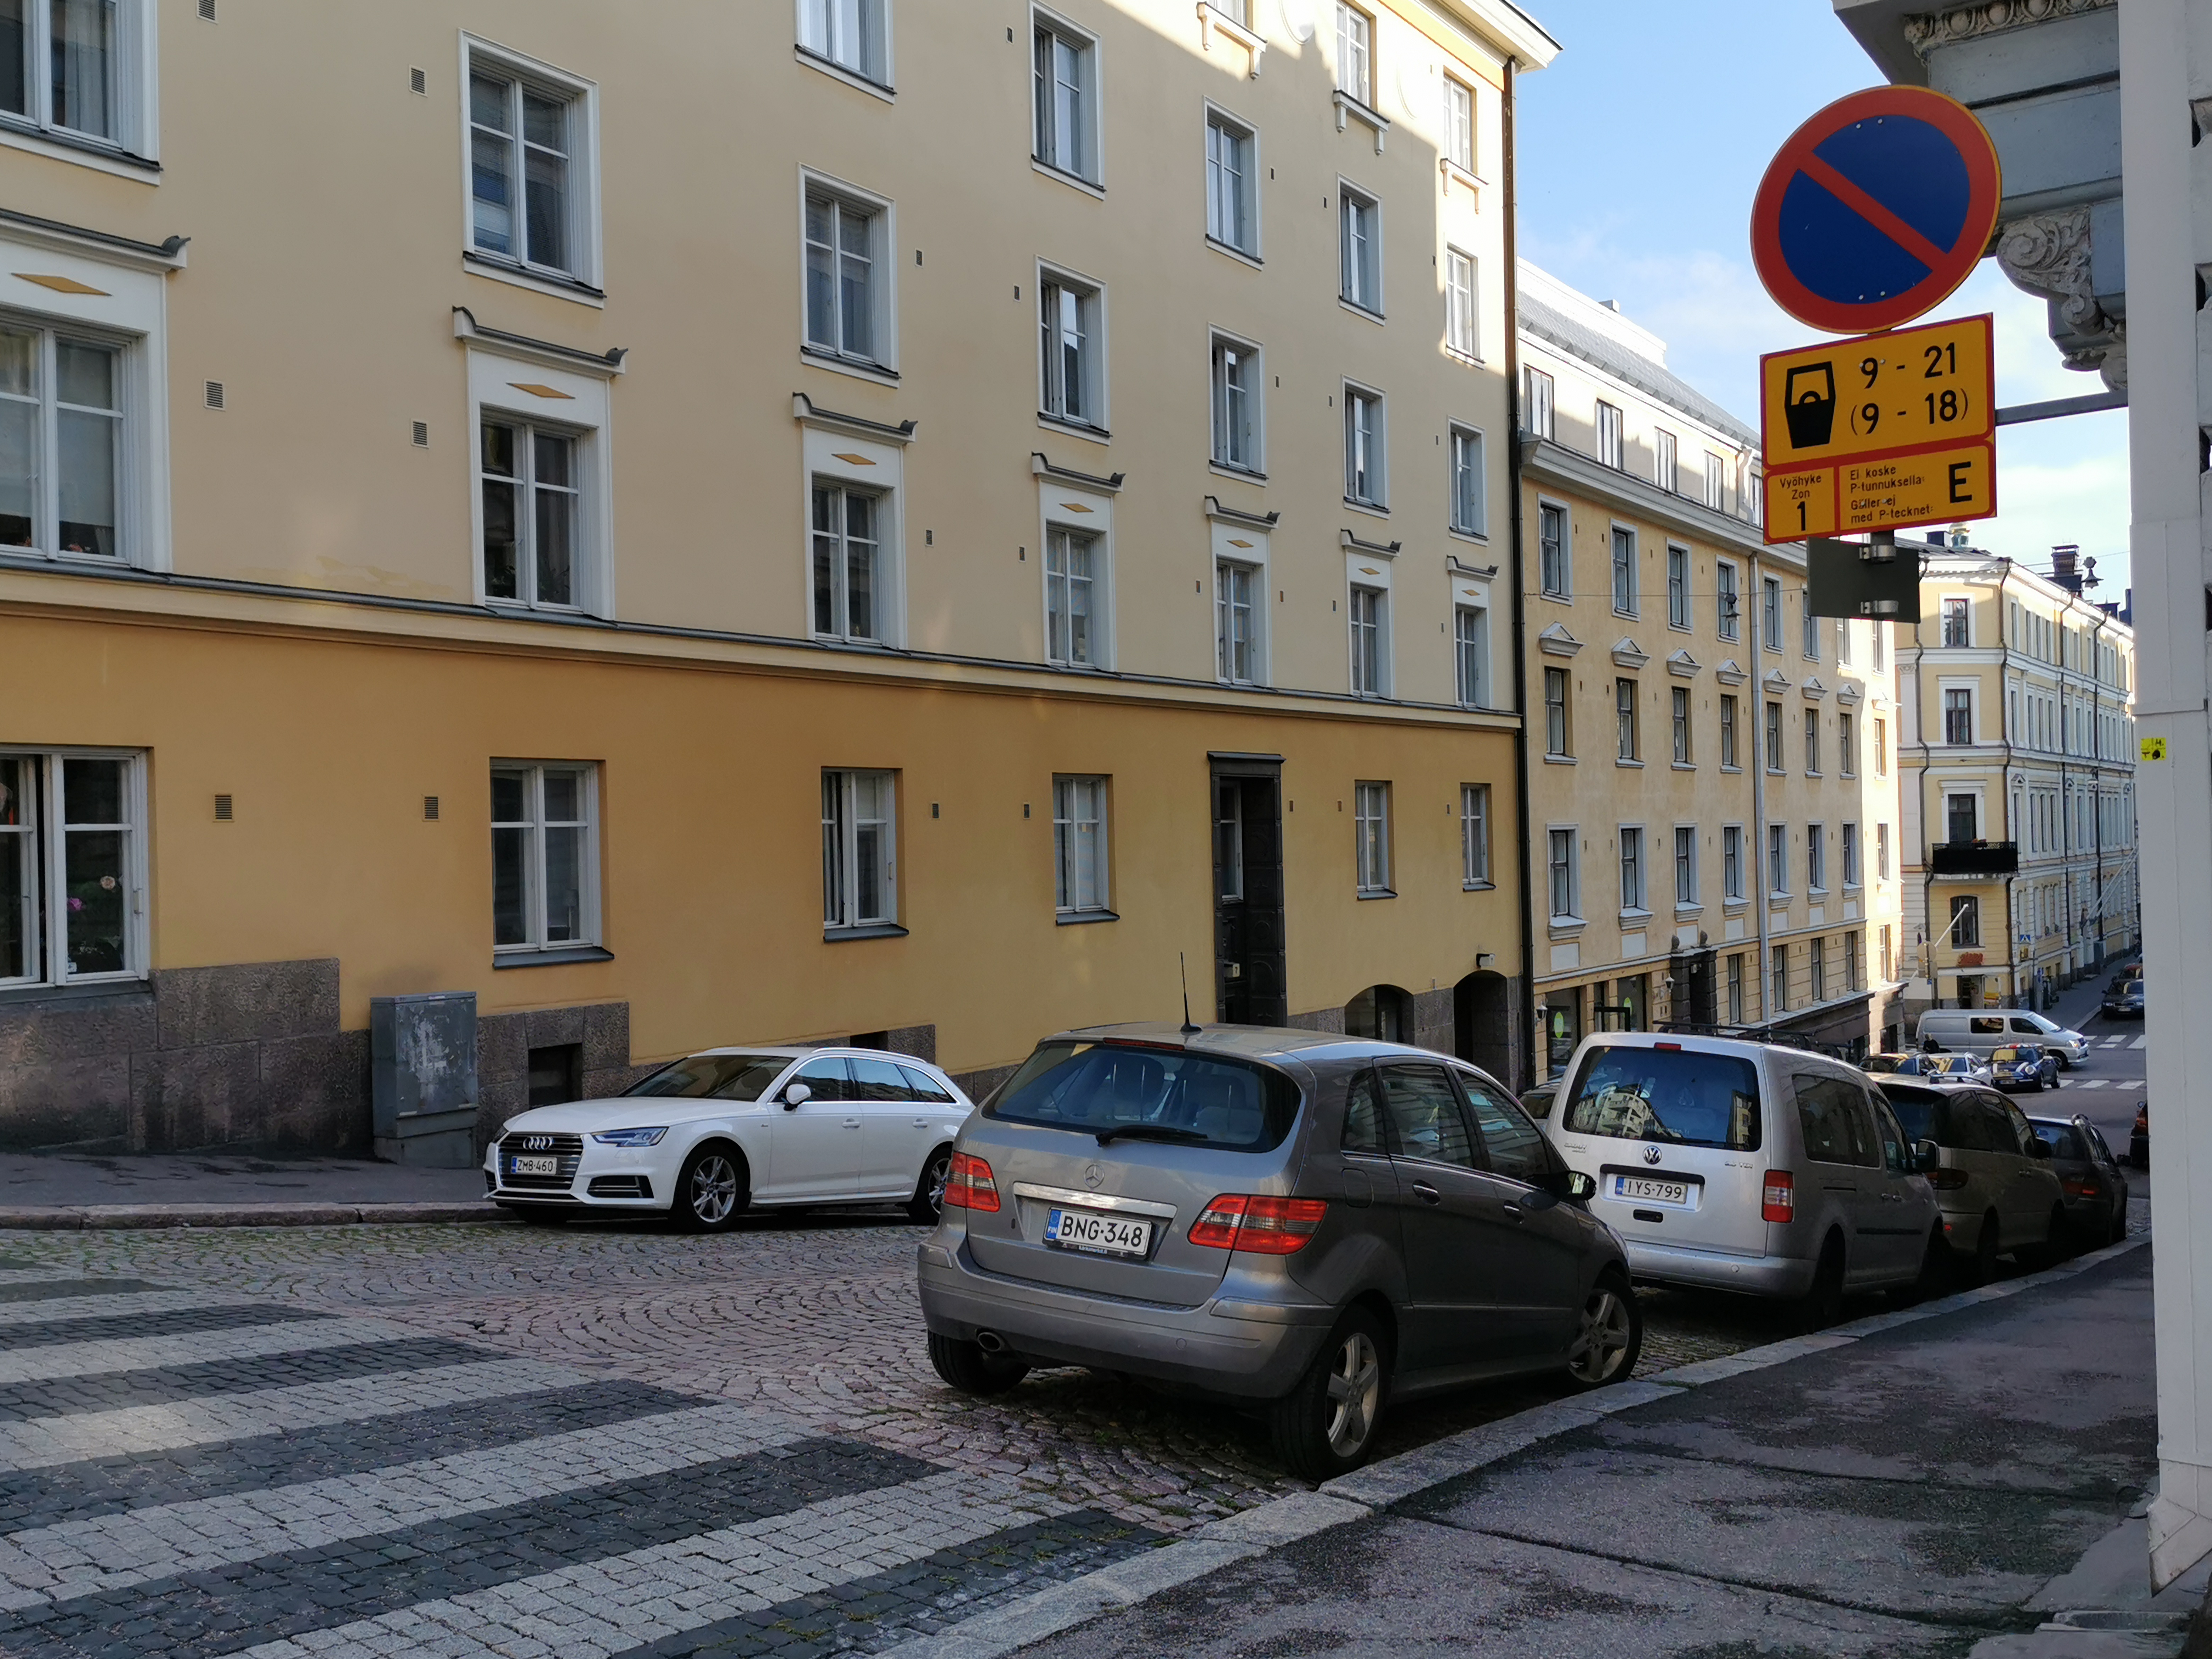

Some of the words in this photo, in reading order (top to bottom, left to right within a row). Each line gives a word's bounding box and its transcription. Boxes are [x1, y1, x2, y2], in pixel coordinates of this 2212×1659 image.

[1860, 357, 1879, 389] 9
[1924, 342, 1956, 379] 21
[1850, 402, 1879, 436] (9
[1924, 387, 1968, 425] 18)
[1850, 469, 1859, 480] Ei
[1865, 464, 1896, 478] koske
[1779, 474, 1822, 489] Vyöhyke
[1948, 461, 1973, 504] E
[1791, 489, 1810, 500] Zon
[1886, 494, 1896, 507] ej
[1797, 501, 1806, 531] 1
[1851, 510, 1873, 525] med
[517, 1159, 554, 1172] ZMB-460
[1628, 1180, 1682, 1199] IYS-799
[1061, 1216, 1143, 1247] BNG-348
